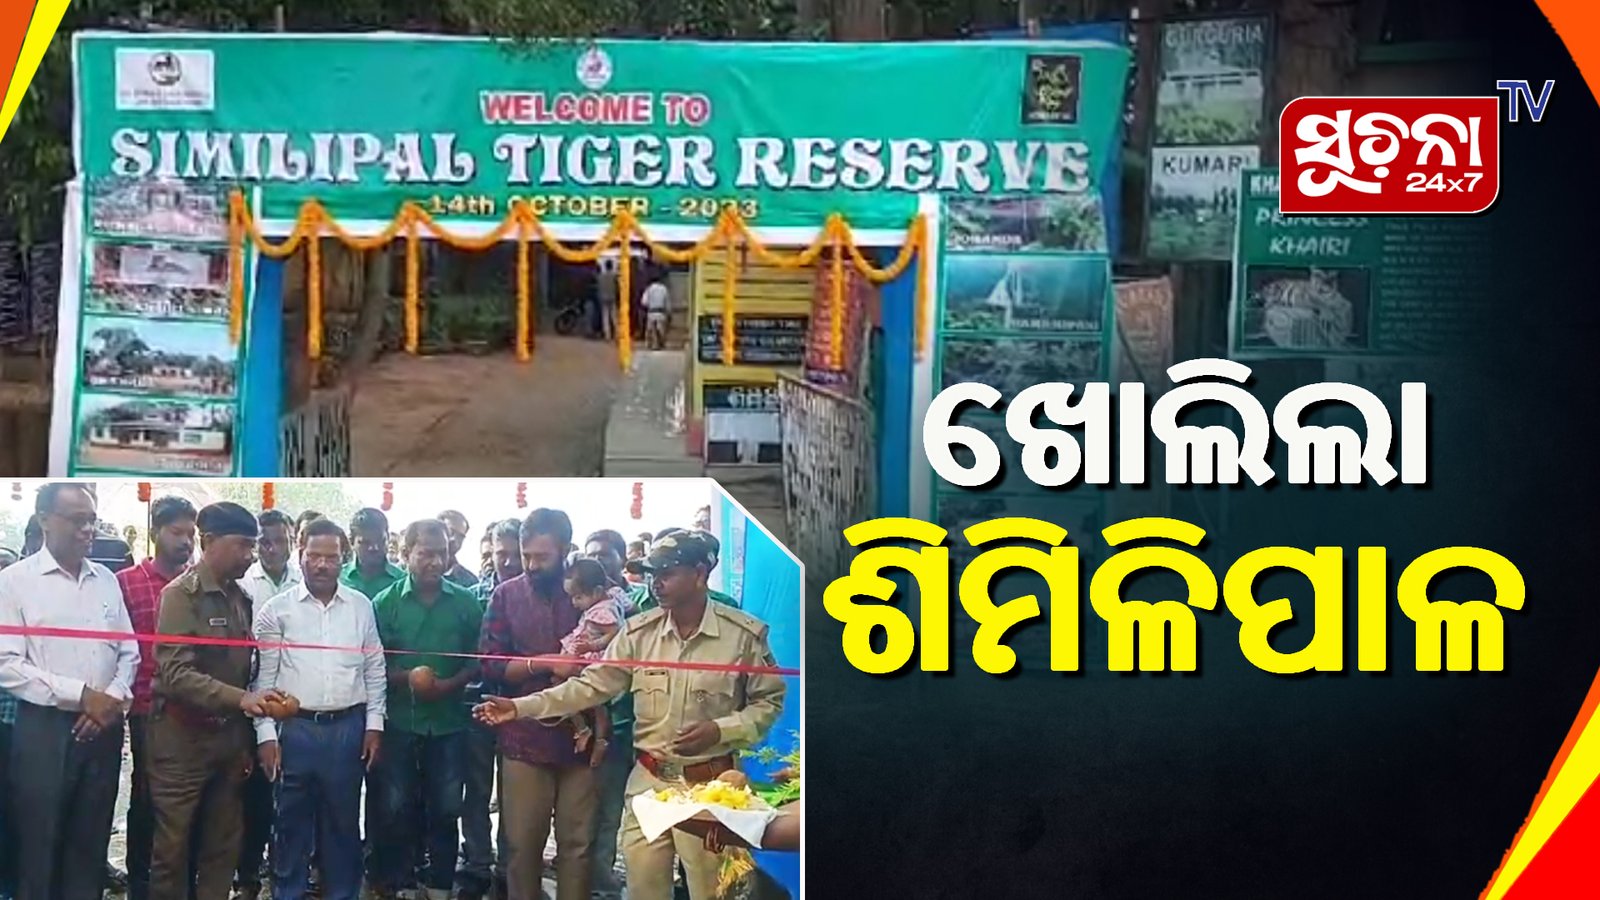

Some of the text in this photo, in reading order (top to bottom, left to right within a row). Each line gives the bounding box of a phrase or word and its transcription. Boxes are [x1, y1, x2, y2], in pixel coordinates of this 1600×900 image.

[480, 91, 711, 126] WELCOME TO
[111, 128, 1090, 192] SIMILIPAL TIGER RESERVE
[1163, 155, 1250, 175] KUMARI
[428, 194, 495, 214] 14th
[1269, 234, 1352, 256] KHAIRI
